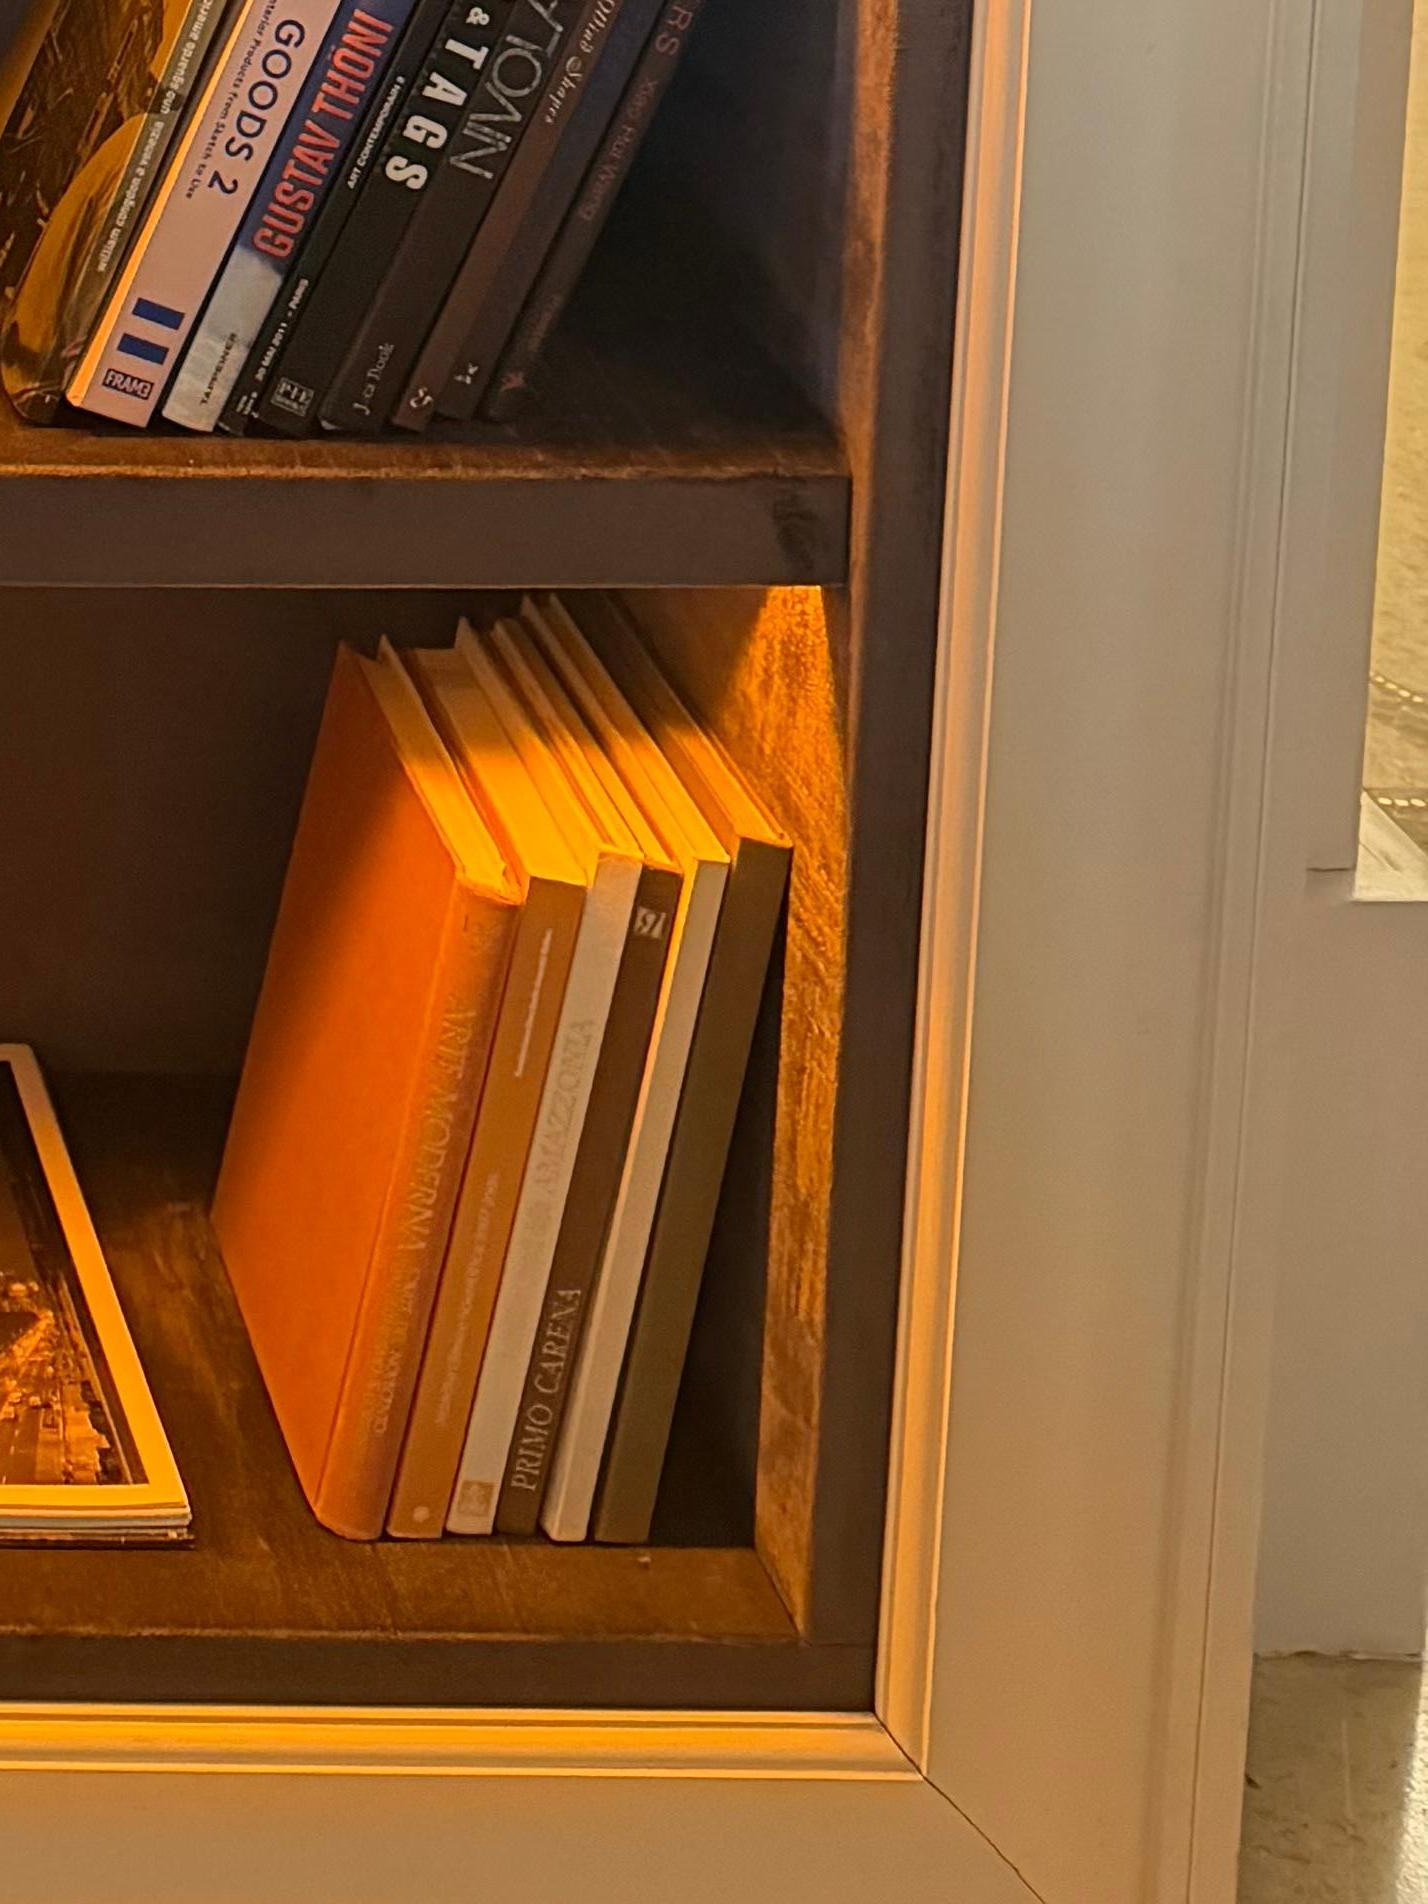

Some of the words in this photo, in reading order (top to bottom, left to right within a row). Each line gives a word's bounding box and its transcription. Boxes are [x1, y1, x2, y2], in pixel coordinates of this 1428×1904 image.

[466, 6, 491, 27] &
[224, 18, 306, 161] GOODS
[238, 38, 264, 90] Products
[546, 55, 584, 124] Shapes
[222, 92, 243, 120] from
[384, 38, 490, 191] TAGS
[115, 177, 142, 229] congdon
[168, 42, 197, 91] sguardo
[203, 121, 227, 161] Sketch
[252, 118, 341, 260] GUSTAV
[312, 8, 394, 121] THÖNI
[193, 162, 206, 177] to
[206, 169, 239, 196] 2
[347, 165, 361, 190] ART
[511, 1403, 555, 1492] PRIMO
